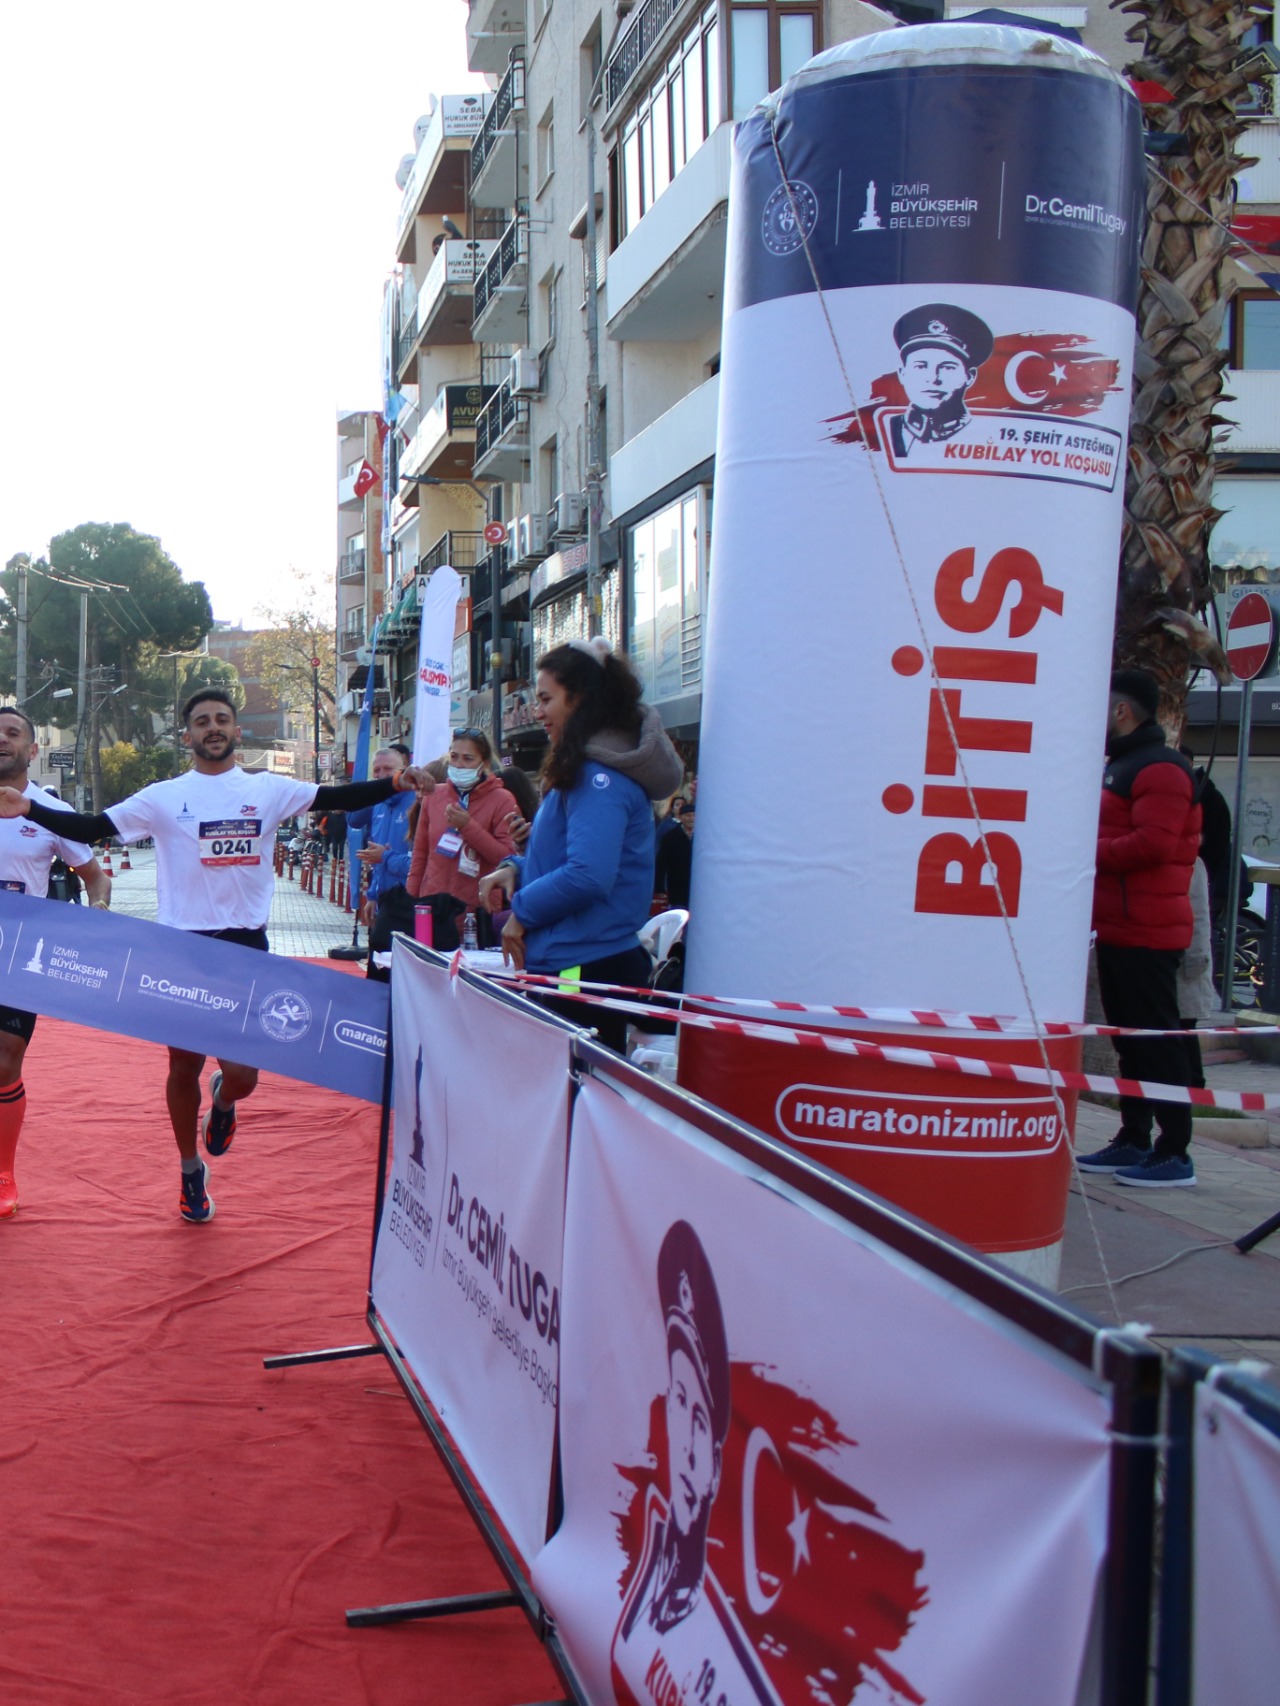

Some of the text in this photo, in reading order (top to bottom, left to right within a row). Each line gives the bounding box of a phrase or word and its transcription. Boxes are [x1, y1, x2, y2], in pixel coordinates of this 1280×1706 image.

[891, 183, 929, 196] İZMİR
[890, 197, 978, 213] BÜYÜKŞEHİR
[889, 215, 971, 229] BELEDİYESİ
[999, 428, 1114, 457] 19. ŞEHİT ASTEĞMEN
[944, 443, 1111, 476] KUBİLAY YOL KOŞUSU
[881, 546, 1064, 918] BİTİŞ
[211, 839, 252, 855] 0241
[52, 944, 79, 960] İZMİR
[47, 968, 102, 989] BELEDİYESİ
[49, 956, 108, 979] BÜYÜKŞEHİR
[794, 1100, 1057, 1142] maratonizmir.org
[406, 1159, 427, 1198] İZMİR
[392, 1176, 433, 1244] BÜYÜKŞEHİR
[389, 1208, 428, 1271] BELEDİYESİ
[447, 1171, 464, 1240] Dr.
[467, 1195, 506, 1297] CEMİL
